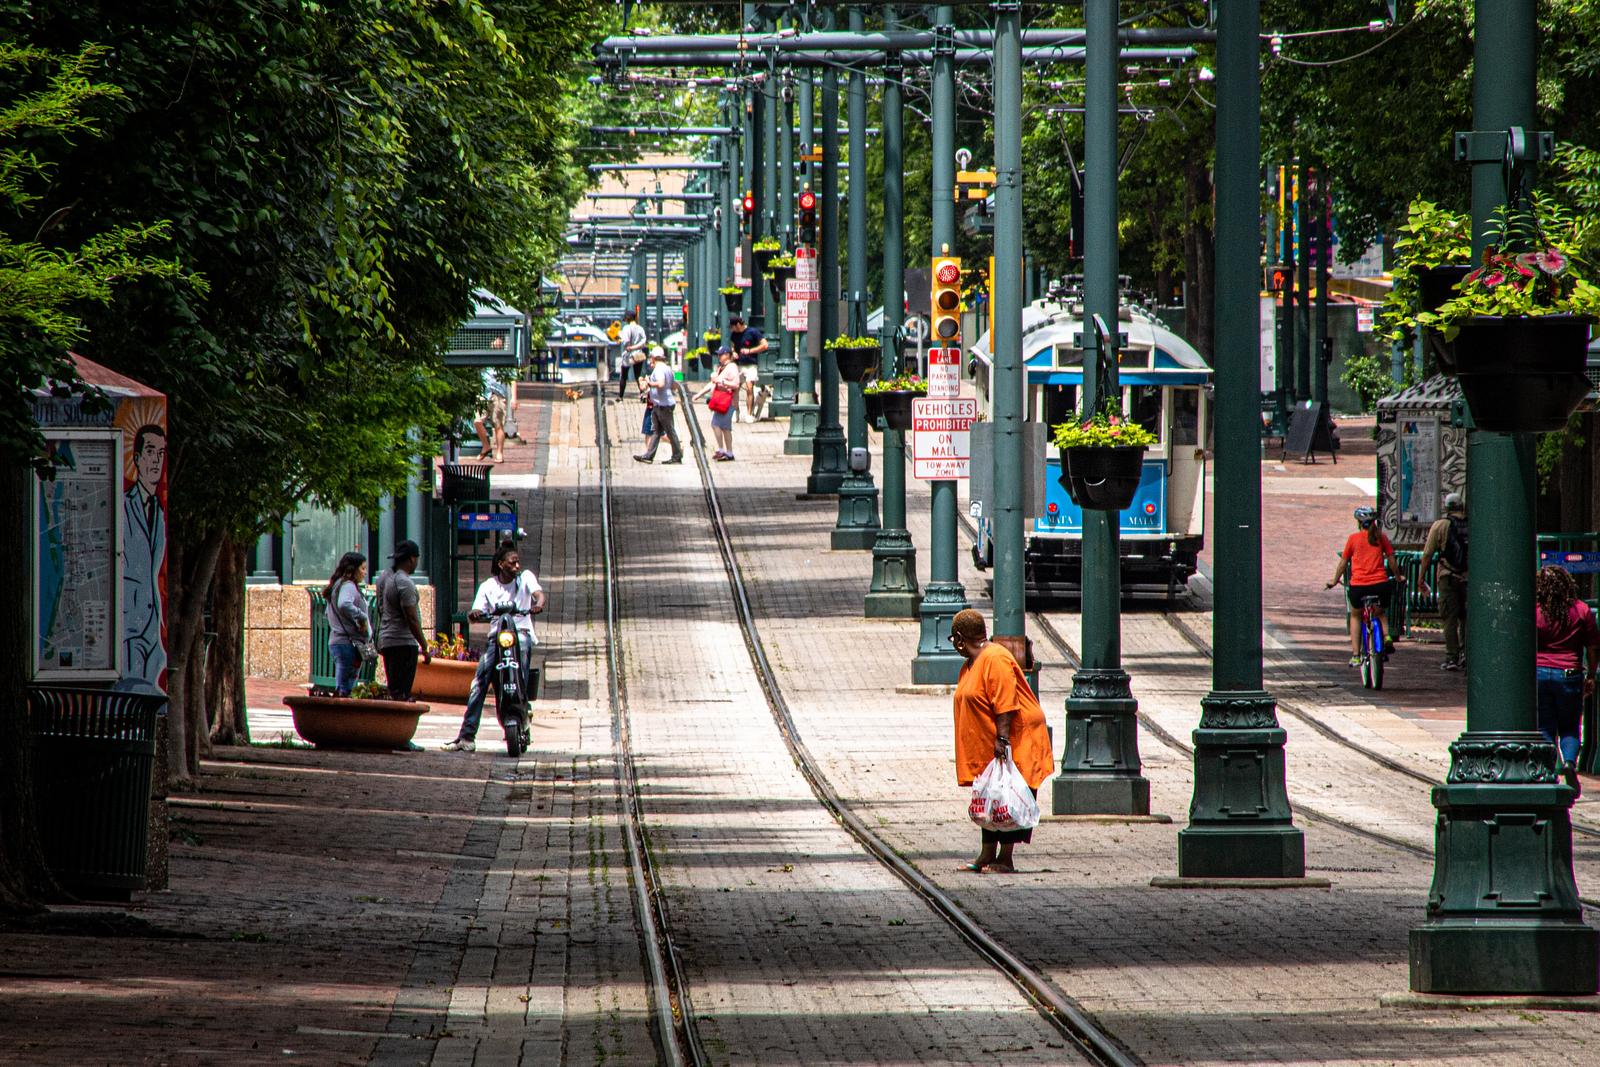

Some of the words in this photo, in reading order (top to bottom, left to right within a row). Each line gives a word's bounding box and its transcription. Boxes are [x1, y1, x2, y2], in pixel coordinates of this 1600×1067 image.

[789, 282, 819, 291] VEHICLE
[788, 291, 819, 299] PROHIBITE
[931, 373, 958, 381] PARKING
[917, 403, 973, 416] VEHICLES
[938, 434, 953, 444] ON
[931, 446, 959, 456] MALL
[1129, 515, 1154, 526] MATA
